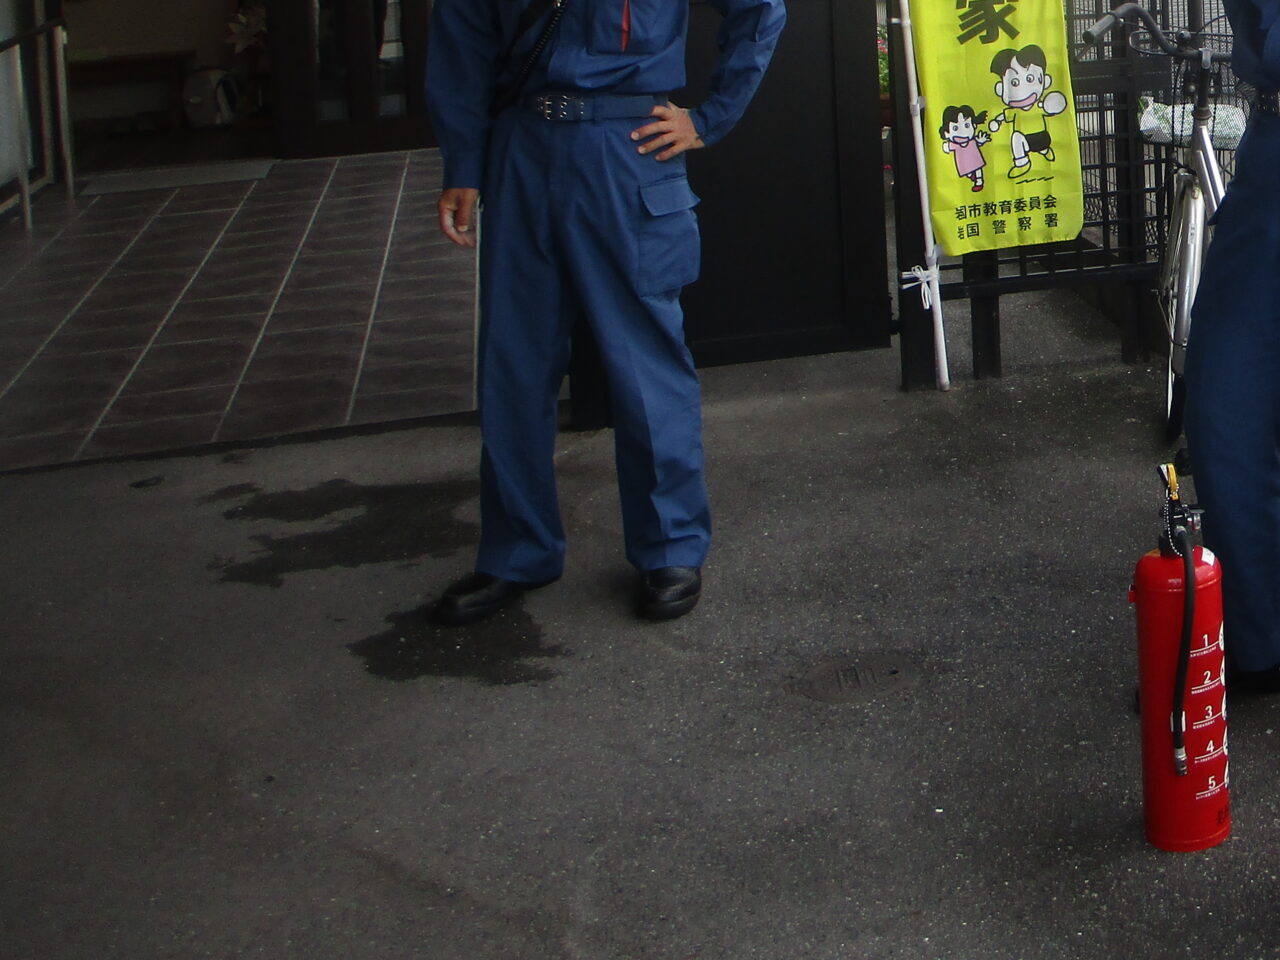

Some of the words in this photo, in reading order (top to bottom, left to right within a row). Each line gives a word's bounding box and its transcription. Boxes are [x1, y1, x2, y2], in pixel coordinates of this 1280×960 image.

[1203, 633, 1210, 647] 1
[1203, 670, 1212, 685] 2
[1205, 705, 1214, 720] 3
[1206, 739, 1215, 753] 4
[1208, 775, 1217, 791] 5
